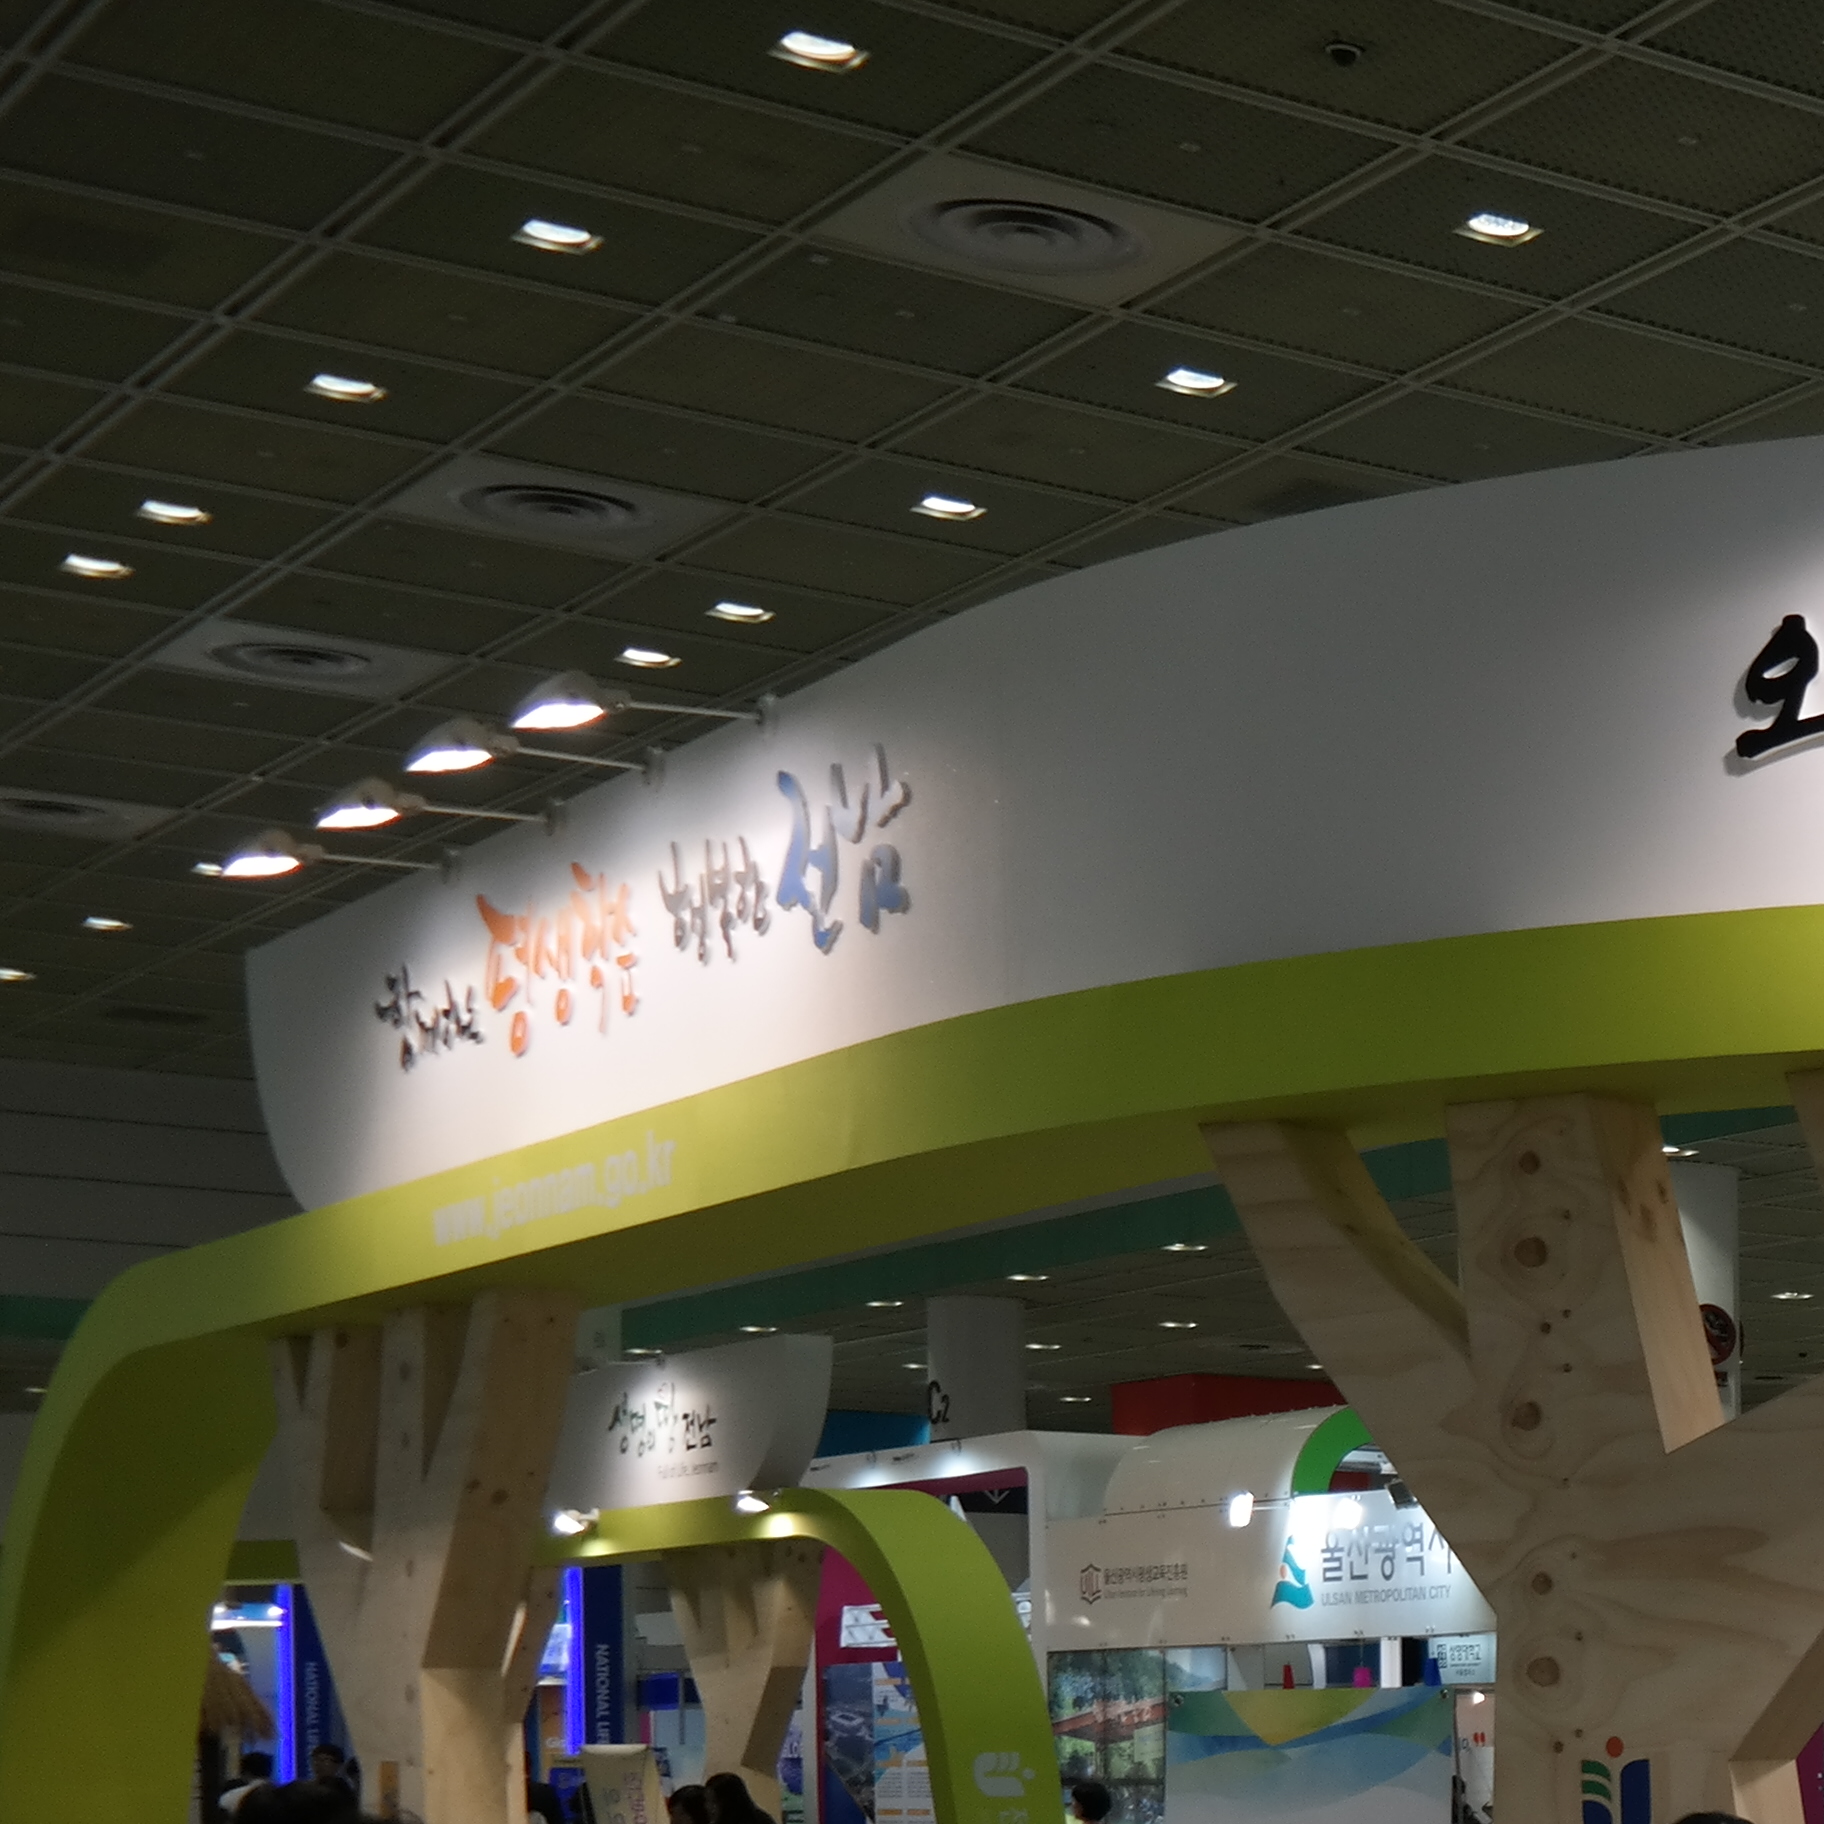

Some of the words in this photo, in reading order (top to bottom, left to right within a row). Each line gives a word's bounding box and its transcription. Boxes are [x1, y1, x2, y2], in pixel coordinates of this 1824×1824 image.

[777, 743, 912, 954] 전남
[683, 1404, 717, 1451] 전남
[1321, 1590, 1354, 1606] ULSAN
[1429, 1584, 1452, 1600] CITY
